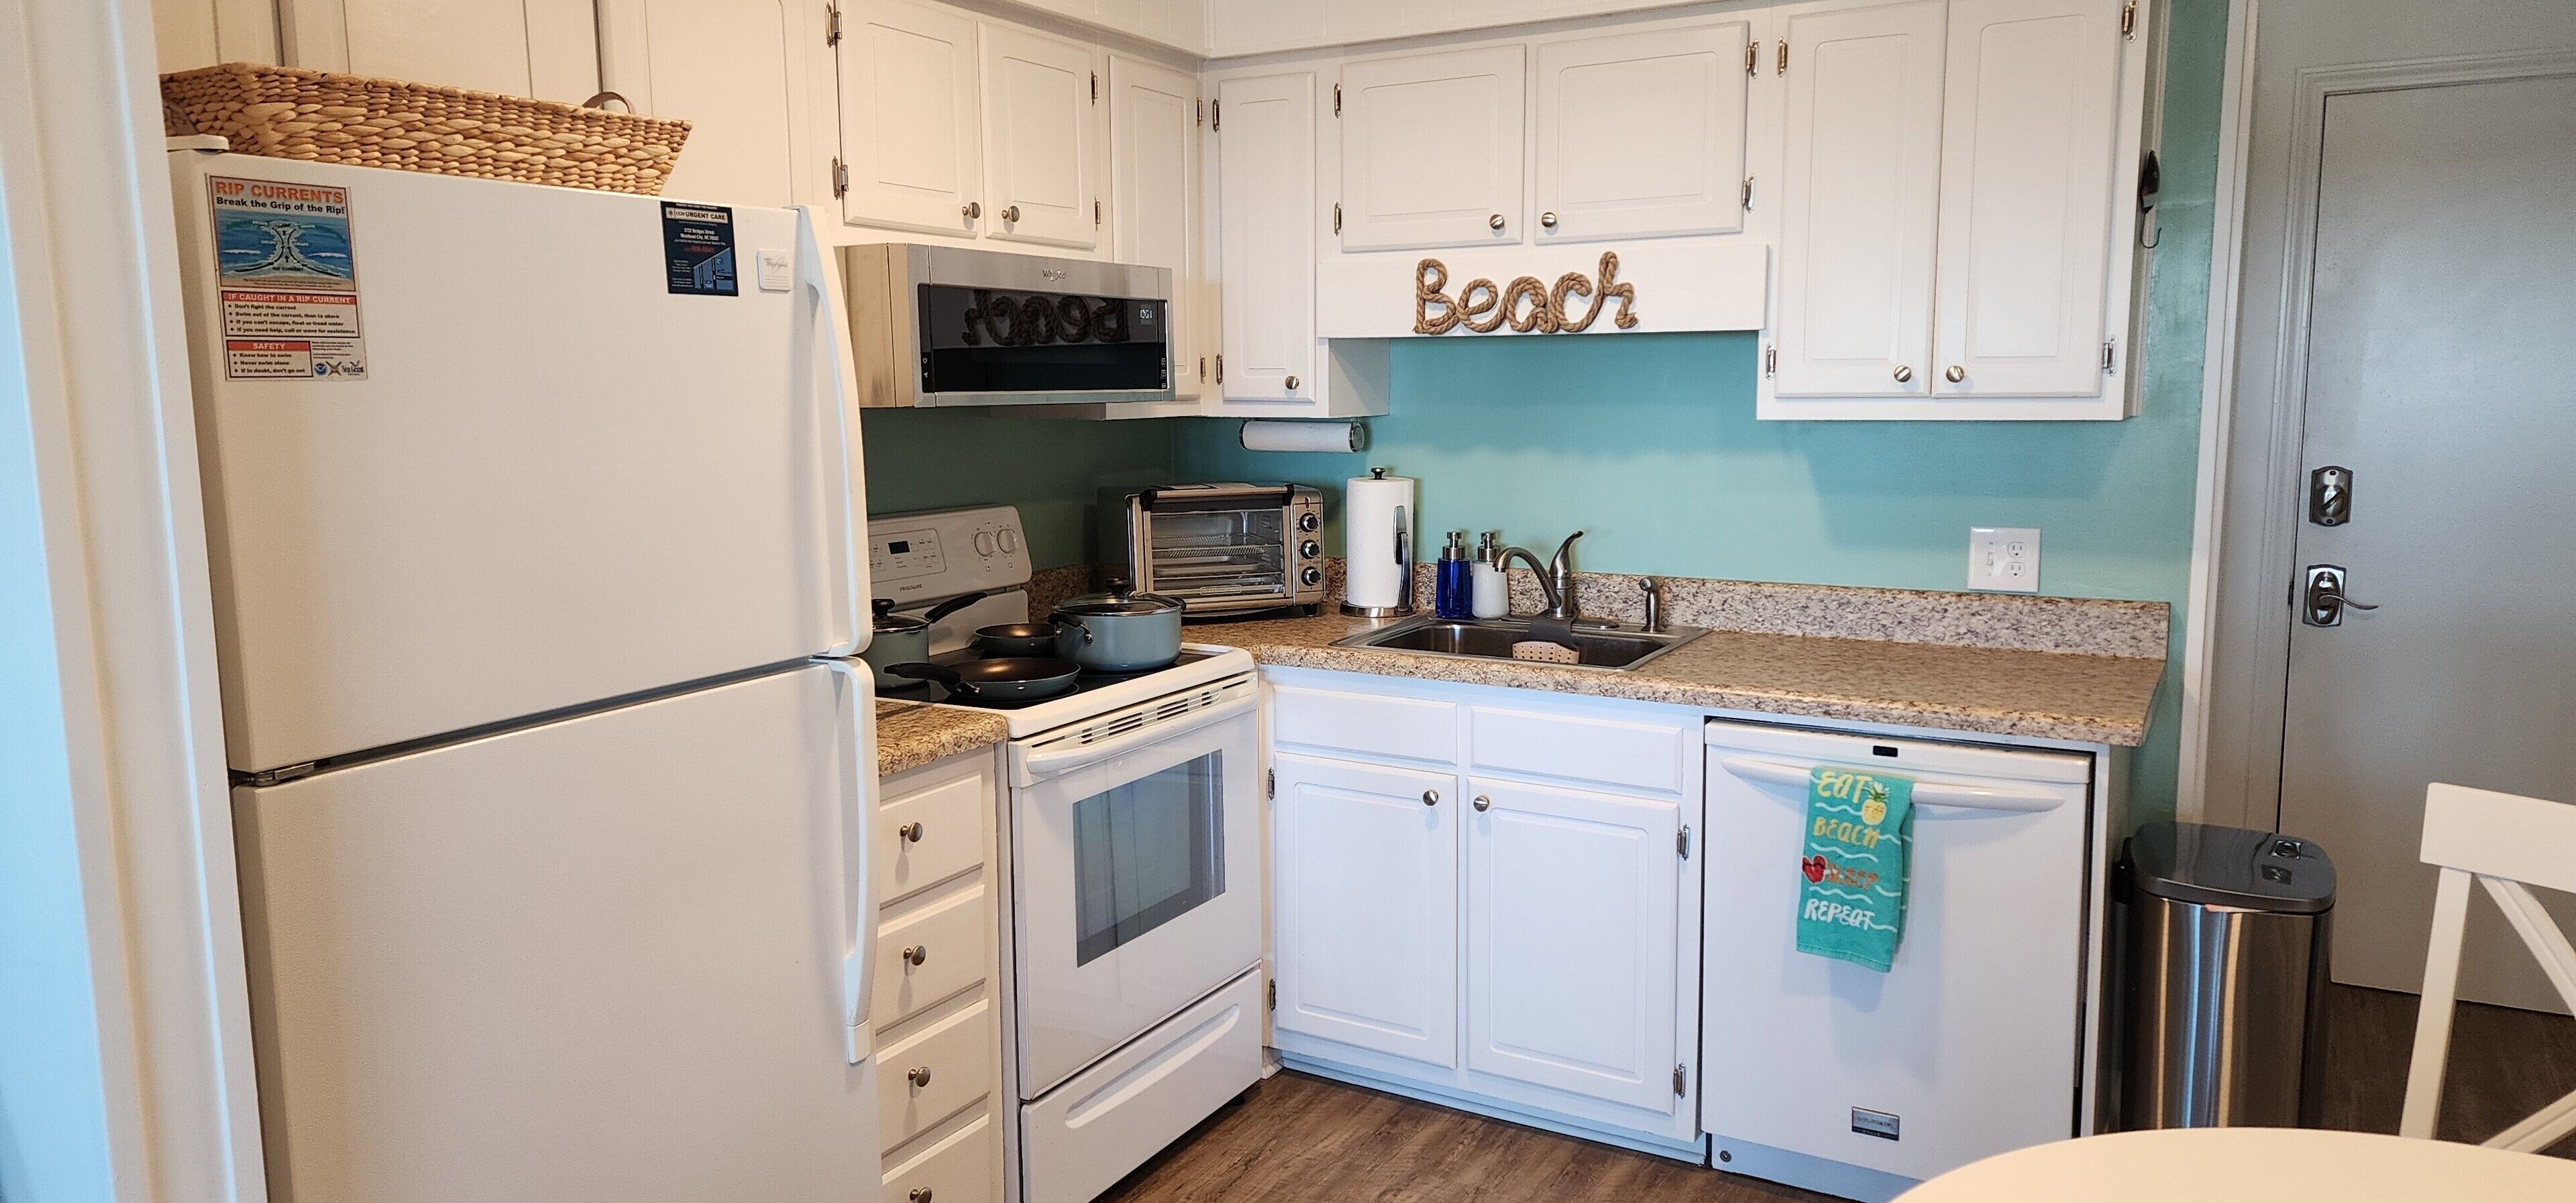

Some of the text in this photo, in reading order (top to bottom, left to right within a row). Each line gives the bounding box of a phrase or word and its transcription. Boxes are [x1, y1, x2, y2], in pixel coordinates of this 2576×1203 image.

[216, 182, 344, 203] RIP CURRENTS
[216, 197, 248, 207] Break
[250, 199, 267, 208] the
[270, 201, 291, 211] Grip
[294, 203, 304, 211] of
[307, 204, 323, 212] the
[239, 294, 274, 302] CAUGHT
[1413, 251, 1638, 335] Beach
[1817, 771, 1874, 804] EAT
[1813, 817, 1880, 849] BEACH
[1804, 898, 1876, 931] REPEAT
